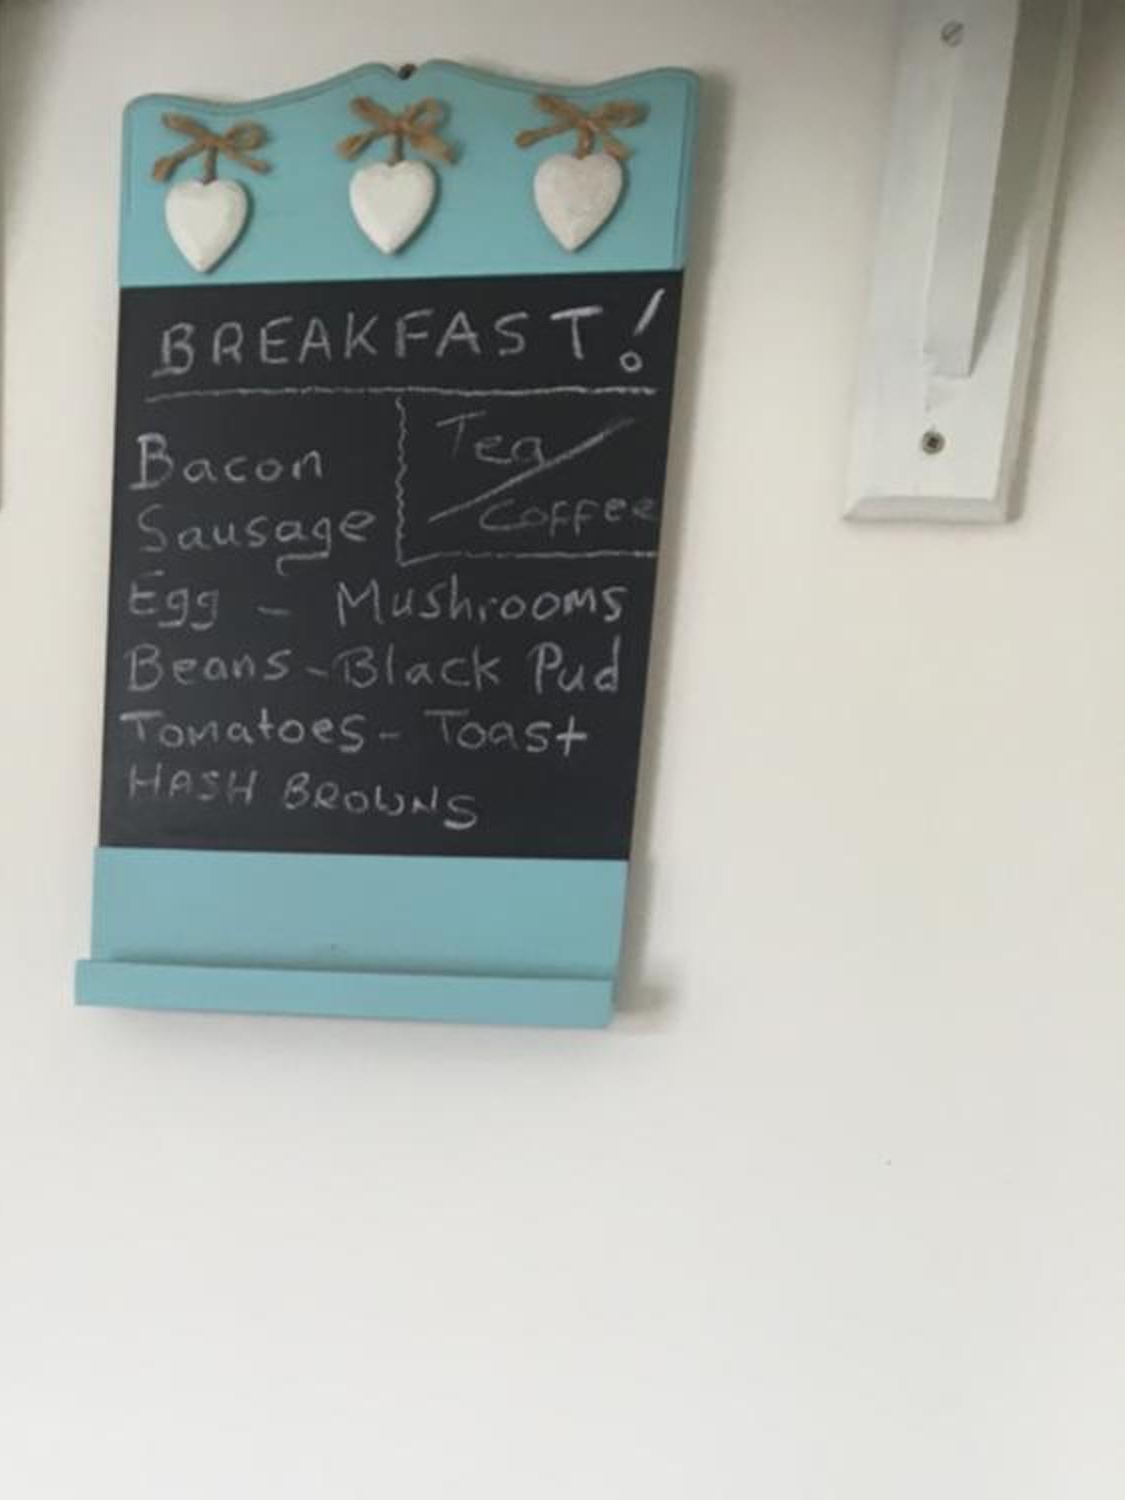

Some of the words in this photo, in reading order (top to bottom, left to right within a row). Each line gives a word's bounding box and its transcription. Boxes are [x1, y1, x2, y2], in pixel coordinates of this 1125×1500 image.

[129, 431, 324, 490] Bacon
[435, 409, 548, 466] Tea
[137, 503, 376, 576] Sausage
[478, 496, 655, 537] Coffee
[126, 569, 220, 630] Egg
[335, 573, 630, 627] Mushrooms
[123, 642, 293, 692] Beans
[332, 643, 502, 691] Black
[528, 636, 621, 694] Pud
[119, 708, 368, 754] Tomatoes
[424, 709, 588, 757] Toast
[127, 762, 258, 804] HASH
[283, 772, 479, 829] BROWNS
